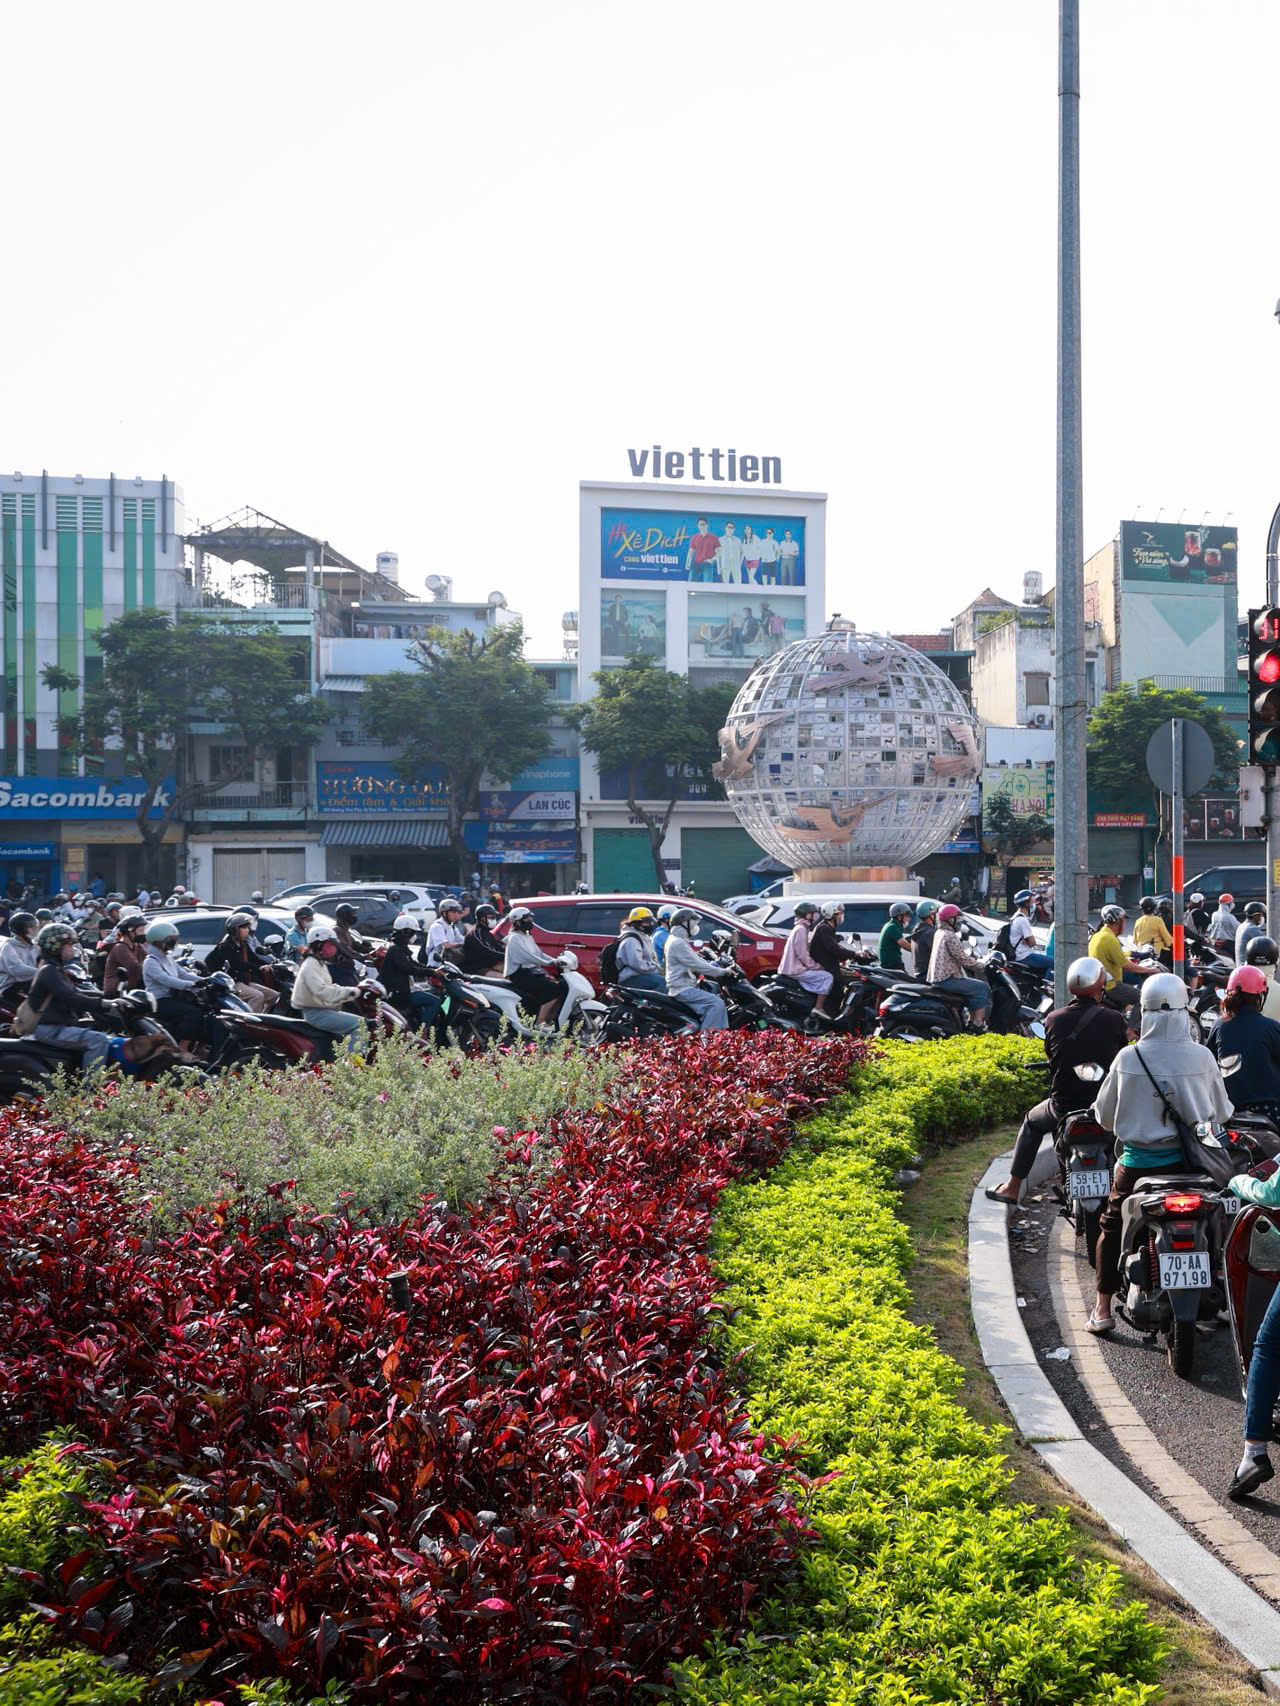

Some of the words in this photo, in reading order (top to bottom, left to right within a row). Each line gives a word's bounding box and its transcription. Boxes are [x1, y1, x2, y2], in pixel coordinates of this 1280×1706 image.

[627, 445, 782, 484] viettien
[641, 553, 678, 564] viettien
[528, 800, 549, 810] LAN
[1075, 1172, 1104, 1186] 59-E1
[1073, 1184, 1108, 1197] 301.17
[1167, 1255, 1202, 1271] 70-AA
[1164, 1270, 1209, 1287] 971.98
